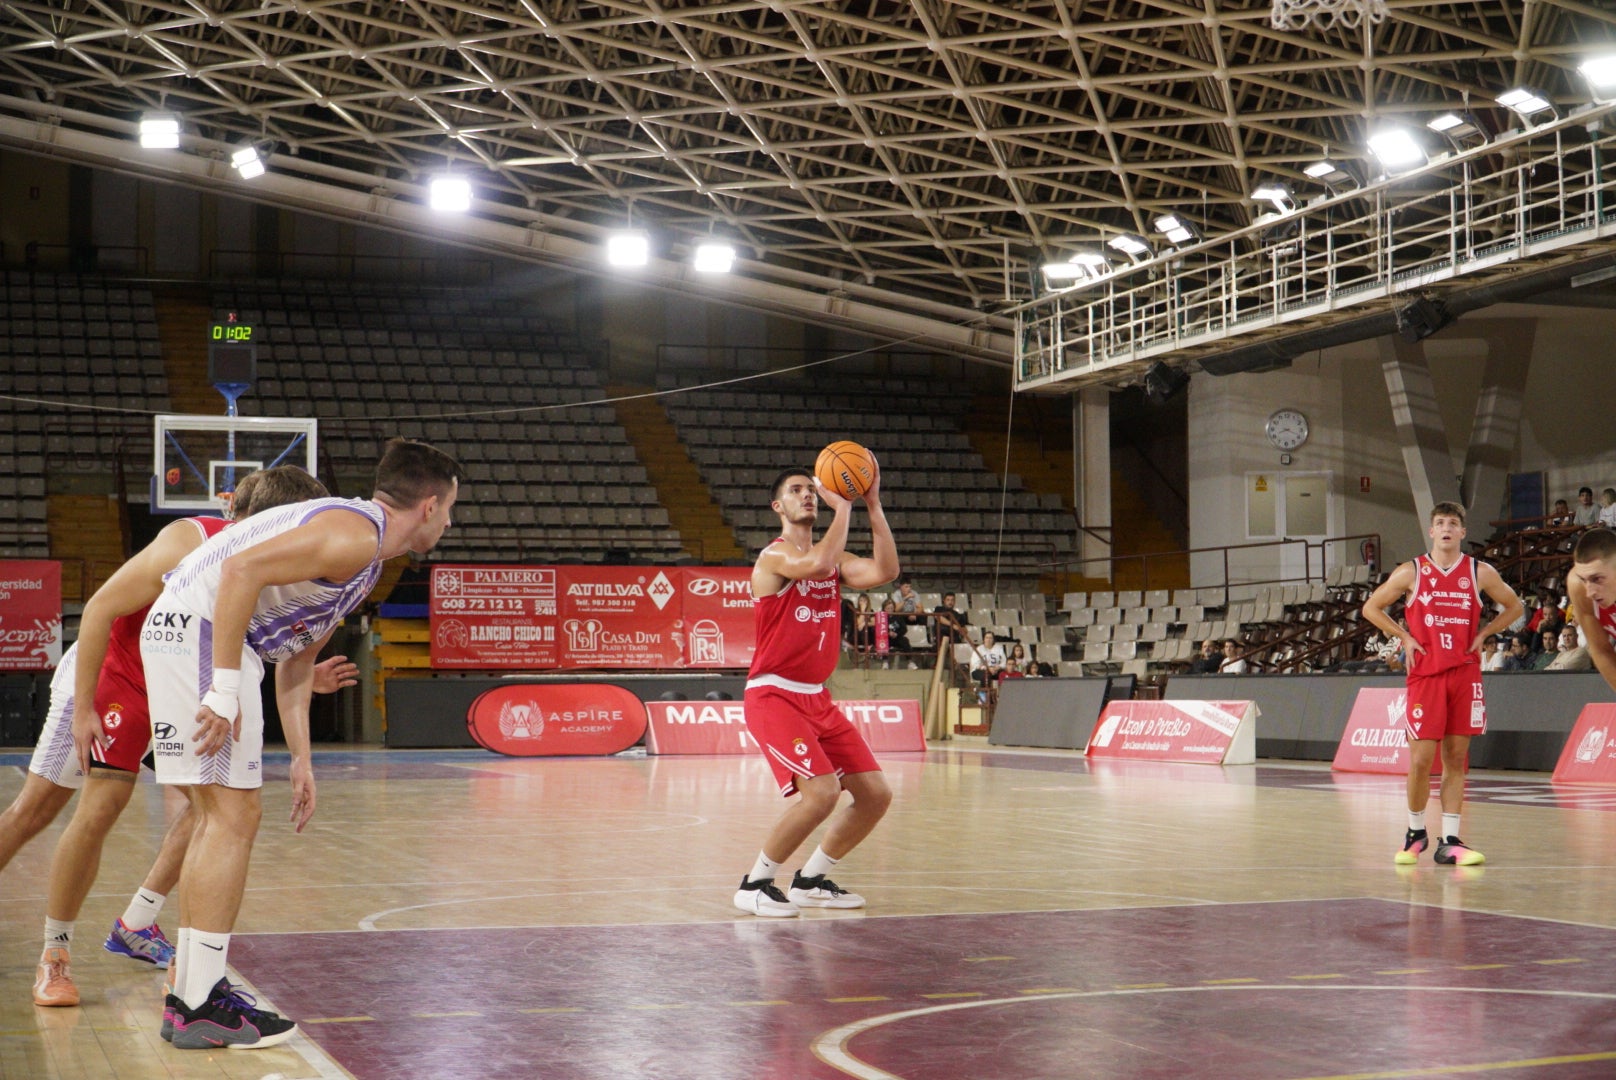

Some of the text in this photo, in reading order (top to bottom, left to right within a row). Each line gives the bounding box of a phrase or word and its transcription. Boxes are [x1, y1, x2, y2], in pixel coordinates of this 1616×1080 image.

[212, 326, 252, 340] 01:02
[474, 571, 543, 582] PALMERO
[0, 579, 42, 590] ersidad
[567, 584, 644, 596] ATILVA
[442, 599, 522, 608] 608 72 12 12
[147, 612, 192, 629] ICKY
[470, 626, 555, 640] RANCHO CHICO III
[636, 631, 660, 643] DIVI
[1440, 633, 1452, 650] 13
[697, 638, 717, 660] R3
[1472, 683, 1483, 699] 13
[549, 710, 623, 722] ASPIRE
[666, 706, 746, 724] MAR
[1351, 728, 1410, 748] CAJA RUR
[118, 928, 159, 956] NIKE
